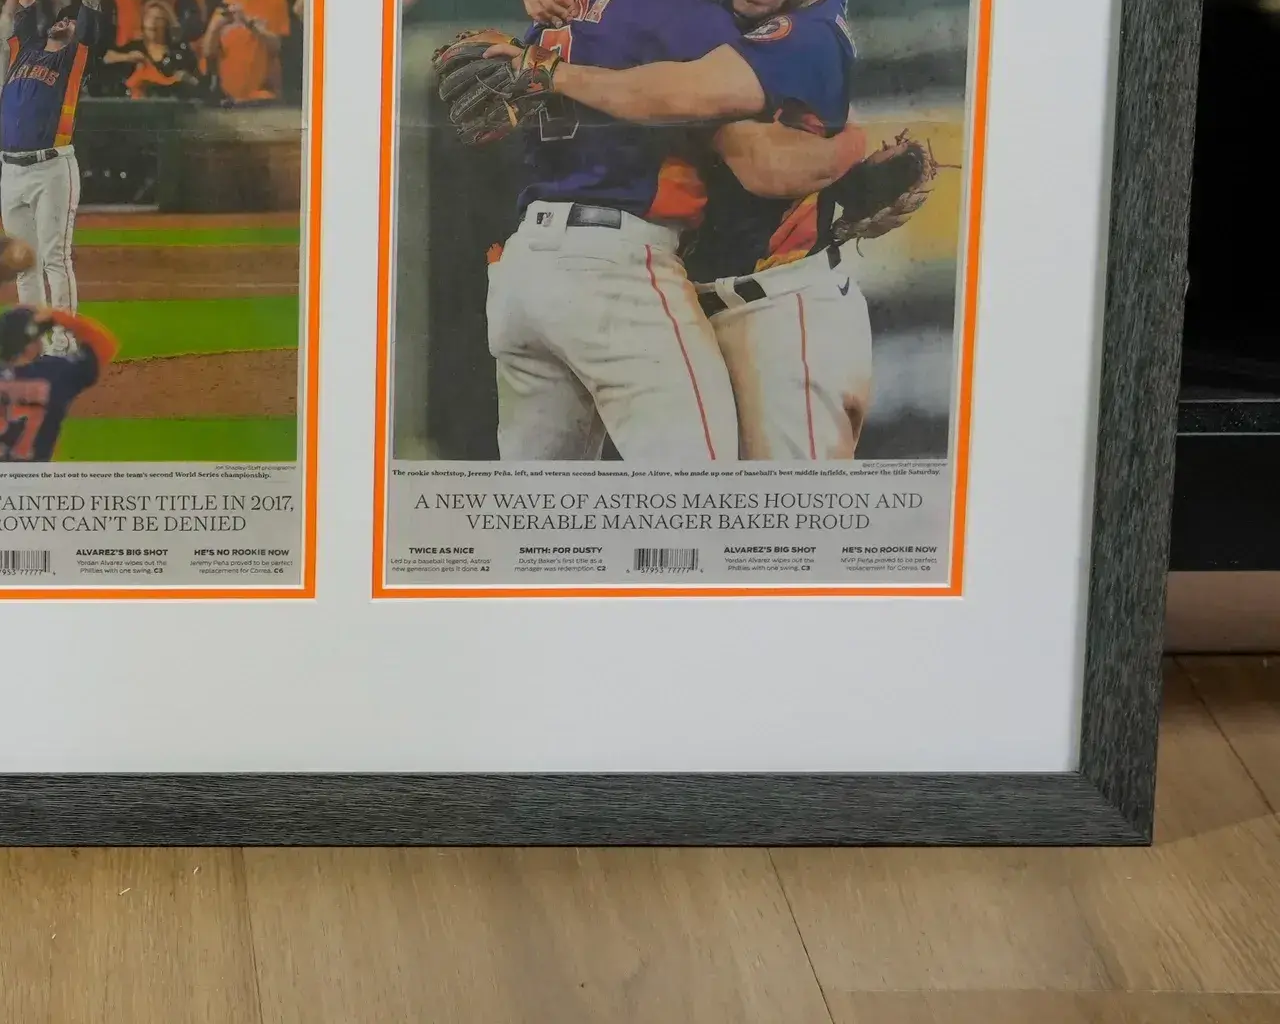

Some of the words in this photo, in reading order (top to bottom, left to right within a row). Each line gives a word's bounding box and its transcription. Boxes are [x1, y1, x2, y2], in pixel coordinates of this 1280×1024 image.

[391, 469, 406, 477] The
[406, 469, 430, 477] rookie
[430, 469, 467, 478] shortstop,
[466, 470, 493, 478] Jeremy
[514, 469, 529, 477] left,
[630, 470, 647, 478] Jose
[734, 469, 744, 477] of
[743, 469, 778, 477] baseball's
[892, 468, 907, 476] title
[908, 468, 940, 476] Saturday.
[90, 495, 151, 511] FIRST
[155, 494, 218, 511] TITLE
[222, 494, 246, 510] IN
[250, 495, 294, 512] 2017,
[414, 494, 430, 509] A
[435, 493, 487, 509] NEW
[492, 494, 556, 509] WAVE
[560, 494, 589, 509] OF
[593, 494, 676, 509] ASTROS
[682, 493, 759, 509] MAKES
[764, 493, 870, 509] HOUSTON
[874, 493, 922, 508] AND
[62, 516, 127, 532] CAN'T
[132, 516, 159, 532] BE
[164, 515, 246, 532] DENIED
[465, 514, 596, 530] VENERABLE
[602, 514, 712, 530] MANAGER
[718, 513, 790, 530] BAKER
[794, 514, 870, 530] PROUD
[75, 548, 125, 556] ALVAREZ'S
[126, 548, 142, 556] BIG
[143, 548, 169, 556] SHOT
[193, 549, 215, 557] HE'S
[231, 548, 266, 556] ROOKIE
[267, 549, 290, 557] NOW
[408, 547, 438, 555] TWICE
[453, 547, 475, 555] NICE
[519, 546, 551, 554] SMITH:
[552, 546, 571, 554] FOR
[572, 546, 603, 554] DUSTY
[723, 546, 773, 554] ALVAREZ'S
[773, 546, 790, 554] BIG
[790, 546, 817, 554] SHOT
[841, 546, 863, 554] HE'S
[864, 546, 879, 554] NO
[879, 545, 914, 554] ROOKIE
[914, 546, 938, 554] NOW
